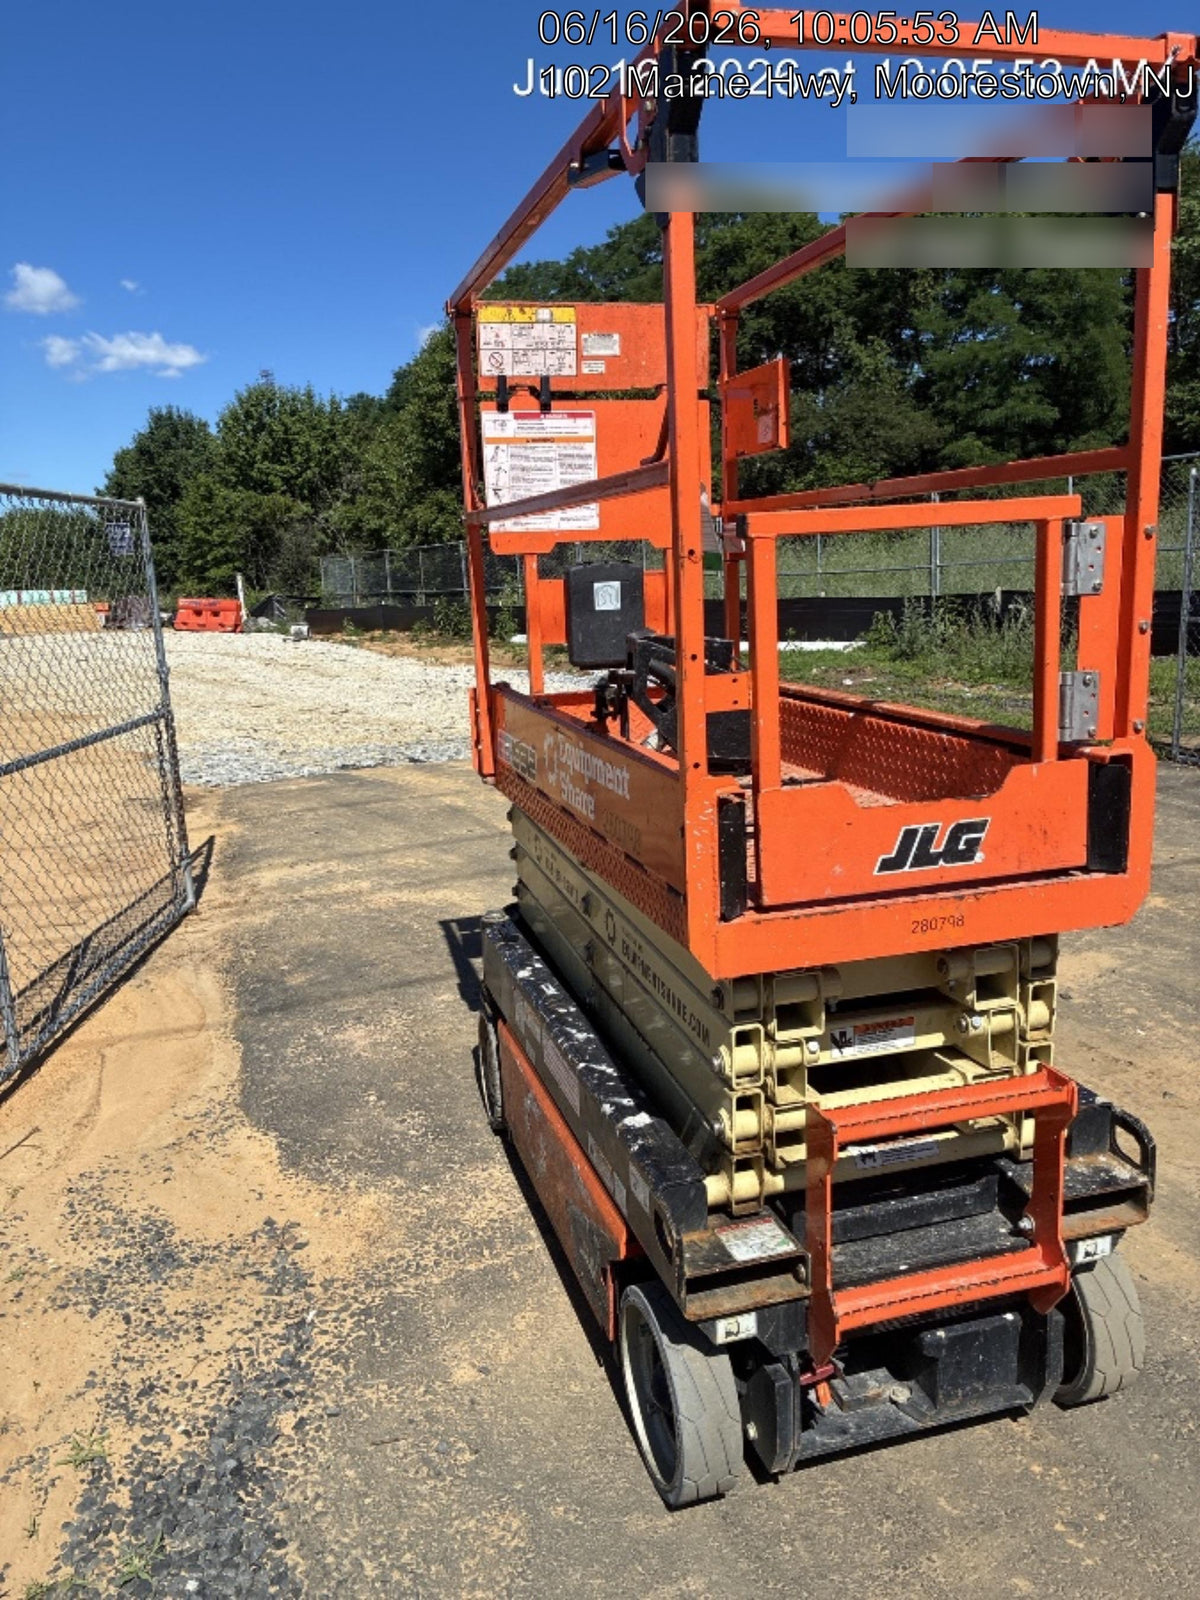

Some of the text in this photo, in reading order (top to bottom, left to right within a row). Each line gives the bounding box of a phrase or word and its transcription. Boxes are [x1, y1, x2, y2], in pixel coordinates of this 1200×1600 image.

[559, 770, 595, 821] Share
[872, 817, 991, 875] JLG
[911, 914, 965, 934] 280798
